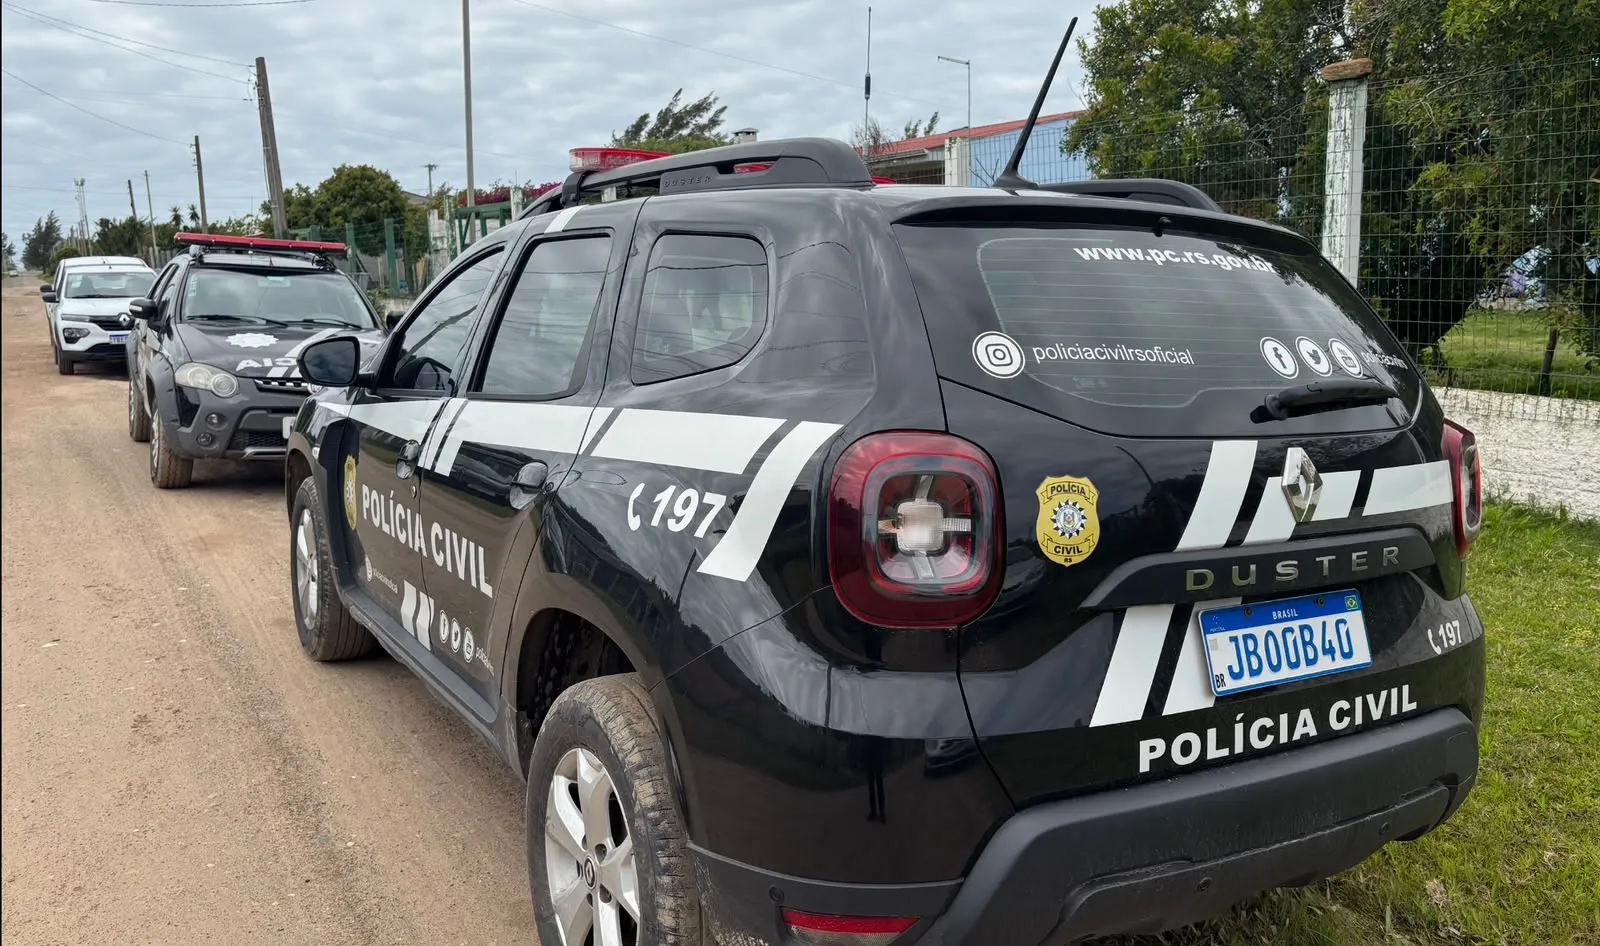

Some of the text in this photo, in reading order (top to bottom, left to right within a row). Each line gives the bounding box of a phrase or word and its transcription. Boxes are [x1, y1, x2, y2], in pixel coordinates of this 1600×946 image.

[663, 175, 712, 188] DUSTER
[1073, 247, 1277, 274] www.pc.rs.gov.br
[1032, 343, 1195, 365] policiacivilrsoficial
[1051, 482, 1086, 495] POLÍCIA
[650, 484, 727, 539] 197
[362, 484, 493, 599] POLÍCIA CIVIL
[1054, 545, 1083, 555] CIVIL
[1185, 546, 1400, 592] DUSTER
[1271, 608, 1299, 620] BRASIL
[1438, 619, 1462, 648] 197
[1215, 673, 1226, 689] BR
[1138, 683, 1418, 774] POLÍCIA CIVIL
